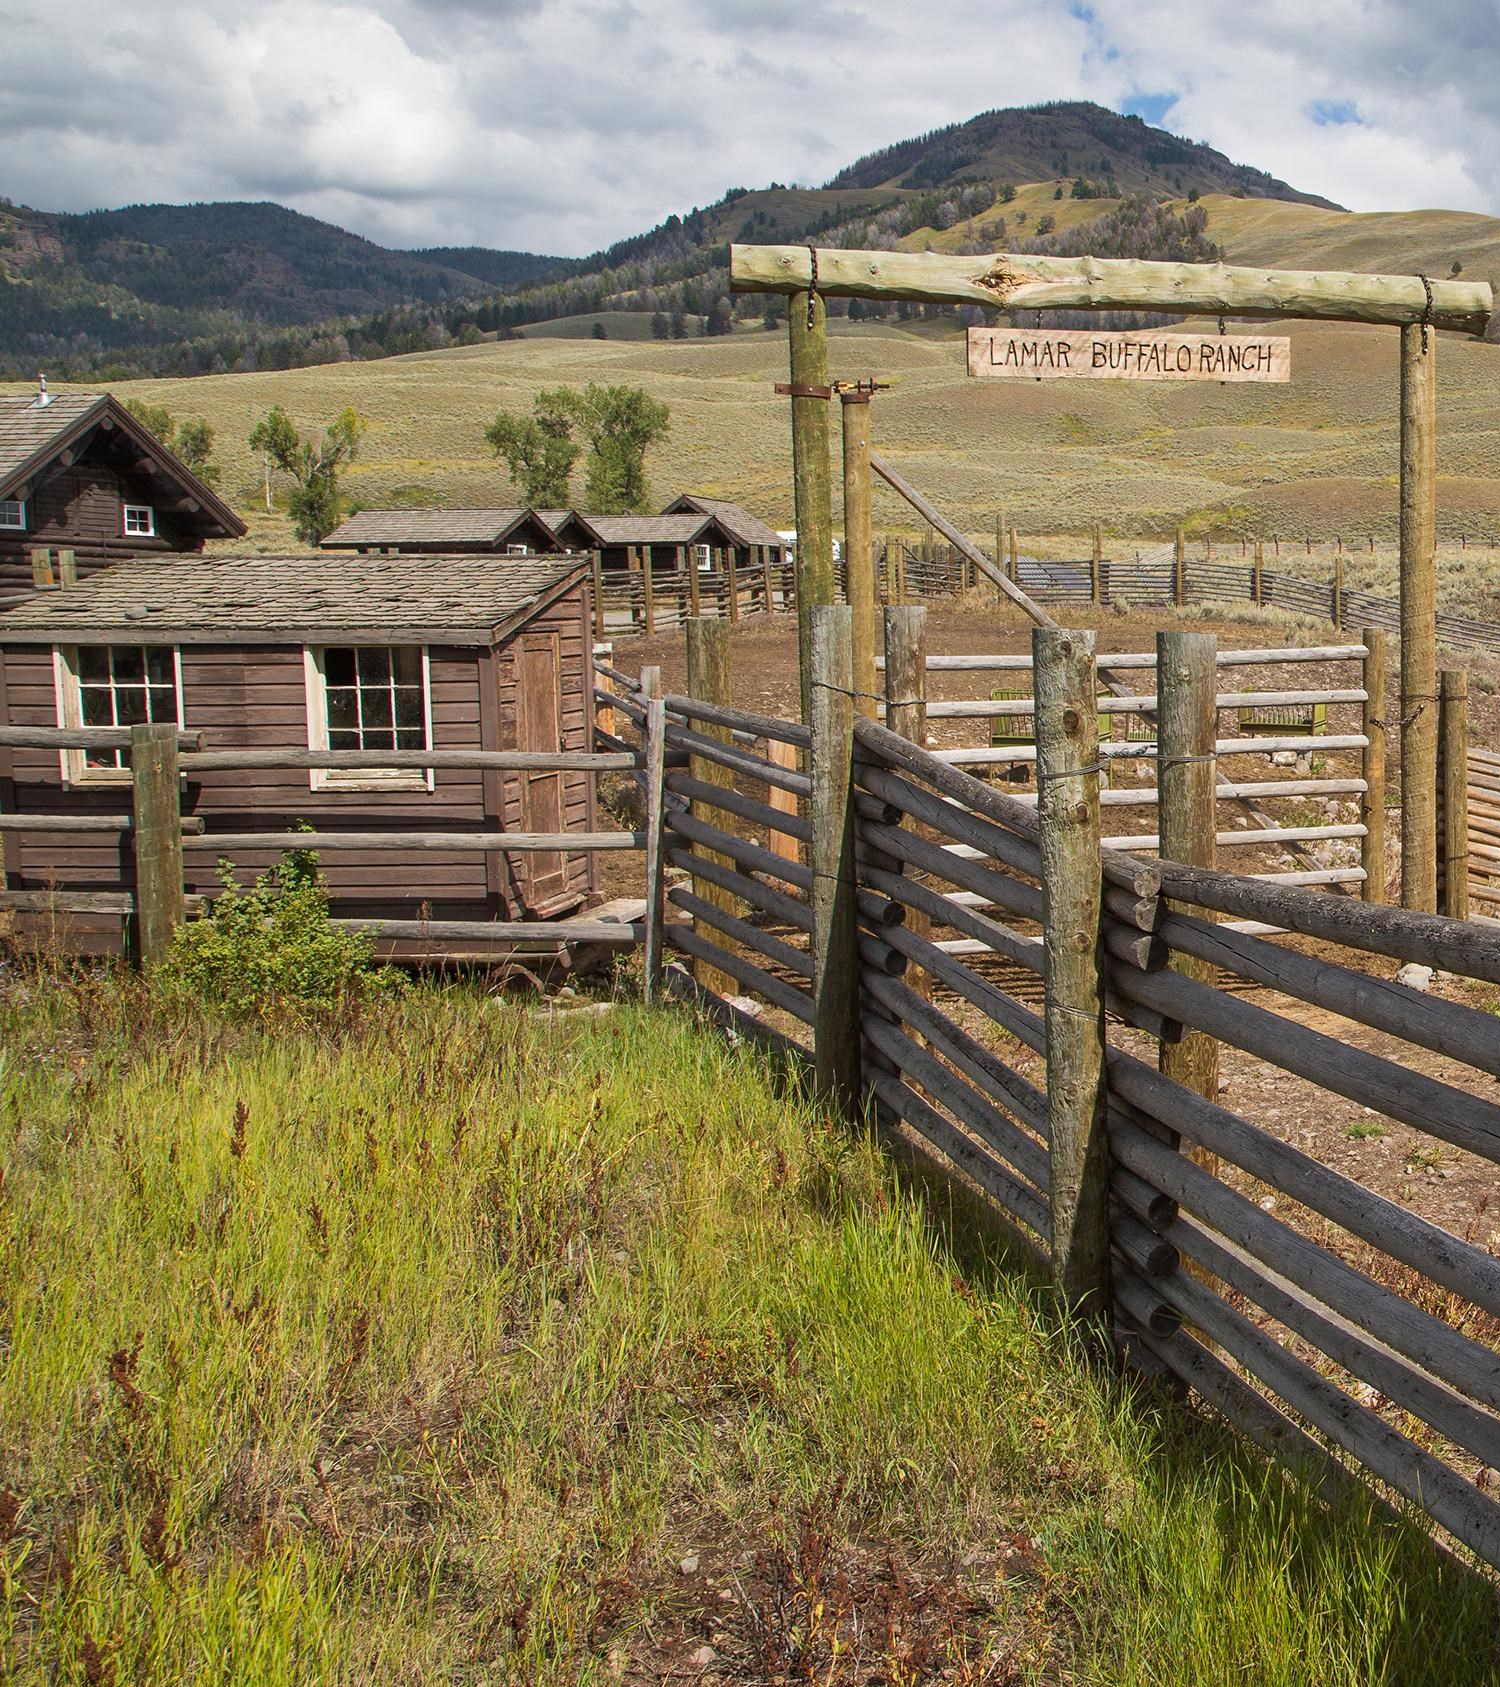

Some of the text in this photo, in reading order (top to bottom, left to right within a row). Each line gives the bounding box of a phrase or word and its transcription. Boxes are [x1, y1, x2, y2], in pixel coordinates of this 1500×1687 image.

[990, 337, 1272, 373] LAMAR BUFFALO RANCH
